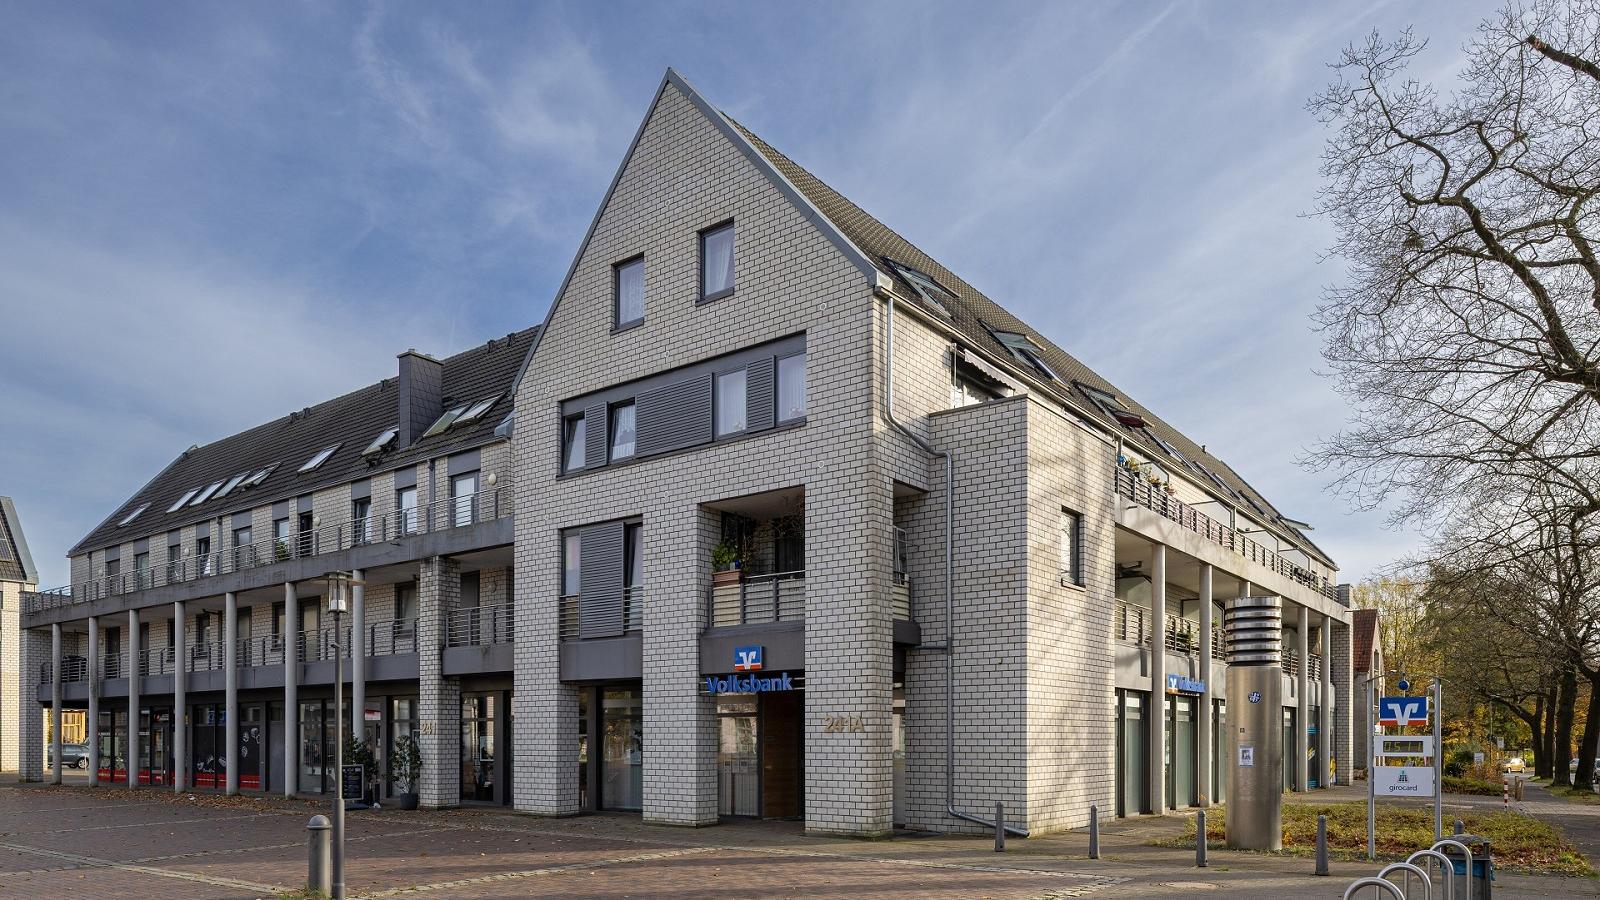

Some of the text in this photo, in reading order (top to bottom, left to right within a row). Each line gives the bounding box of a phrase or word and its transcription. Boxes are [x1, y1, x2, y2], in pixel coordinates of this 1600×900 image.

[705, 672, 793, 693] Volksbank
[824, 714, 865, 733] 241A
[1388, 783, 1418, 793] girocard
